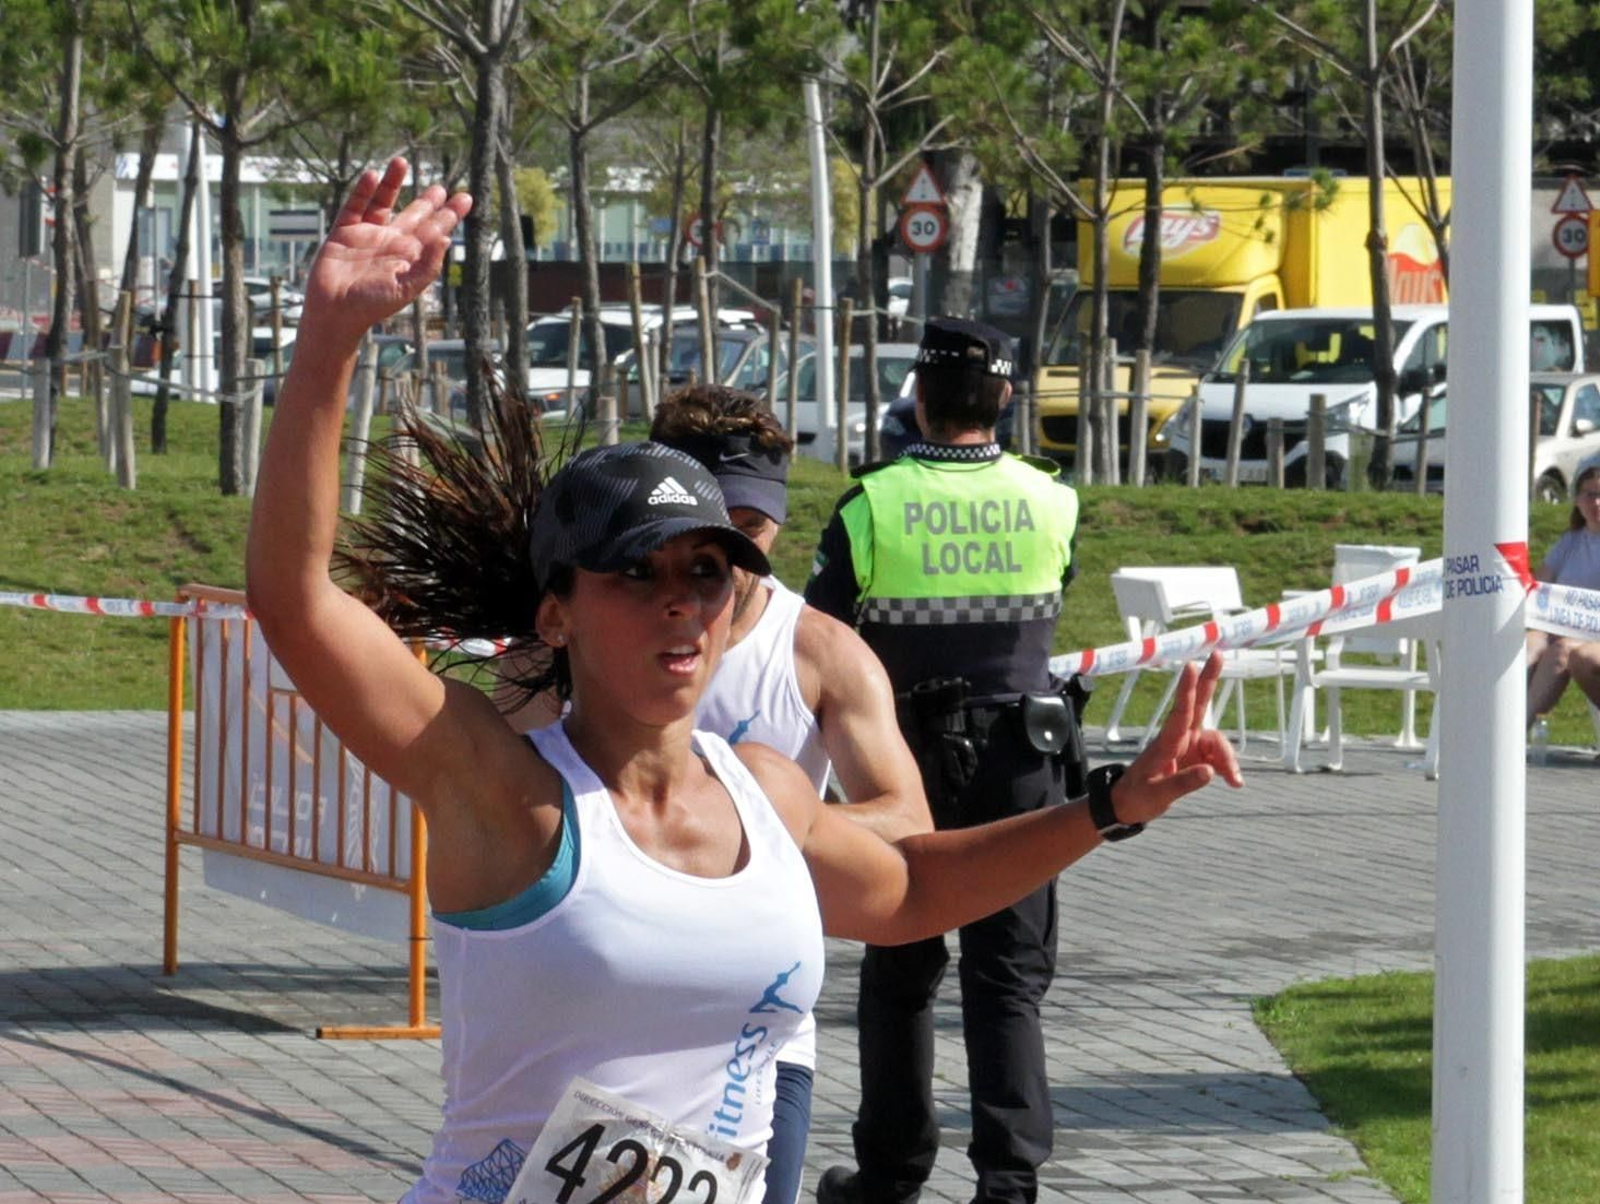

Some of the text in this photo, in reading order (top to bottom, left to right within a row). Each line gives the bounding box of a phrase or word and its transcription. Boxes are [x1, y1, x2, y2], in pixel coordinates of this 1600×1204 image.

[911, 220, 936, 236] 30
[1563, 229, 1587, 244] 30
[648, 494, 698, 506] adidas
[903, 499, 1035, 535] POLICIA
[922, 541, 1022, 575] LOCAL
[708, 1021, 768, 1138] itness
